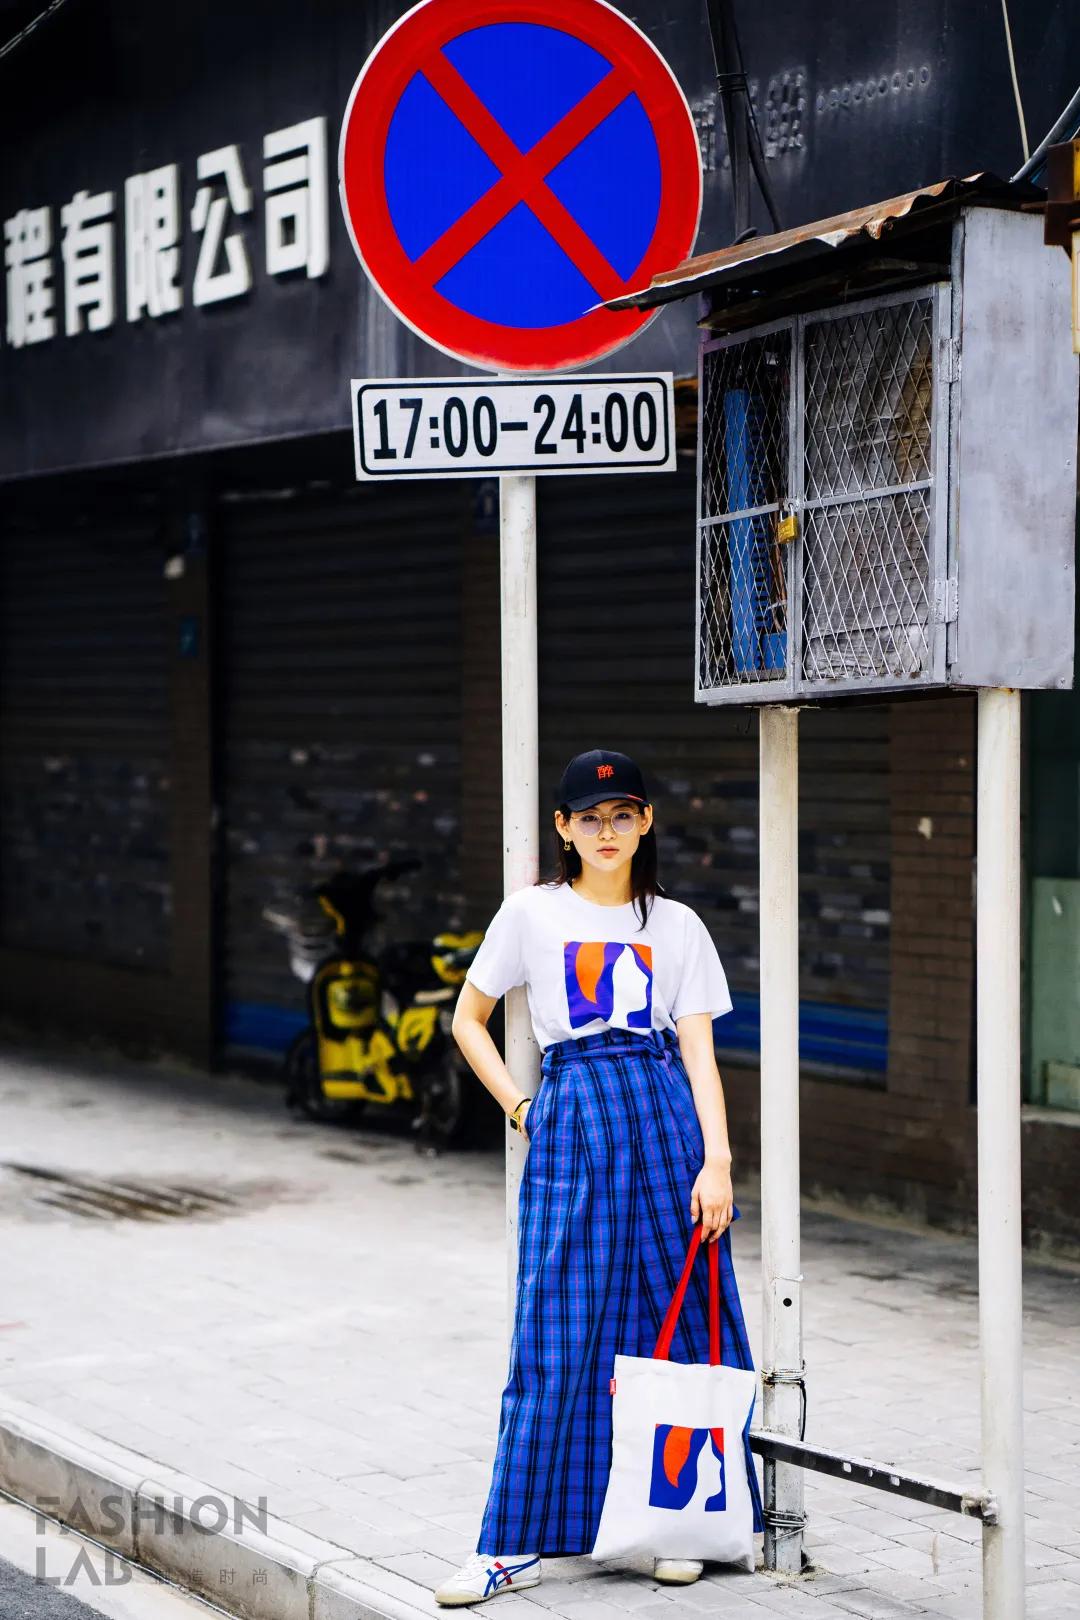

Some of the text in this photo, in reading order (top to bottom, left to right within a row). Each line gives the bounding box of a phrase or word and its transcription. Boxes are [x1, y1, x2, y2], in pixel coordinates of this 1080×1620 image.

[4, 116, 330, 349] 程有限公司
